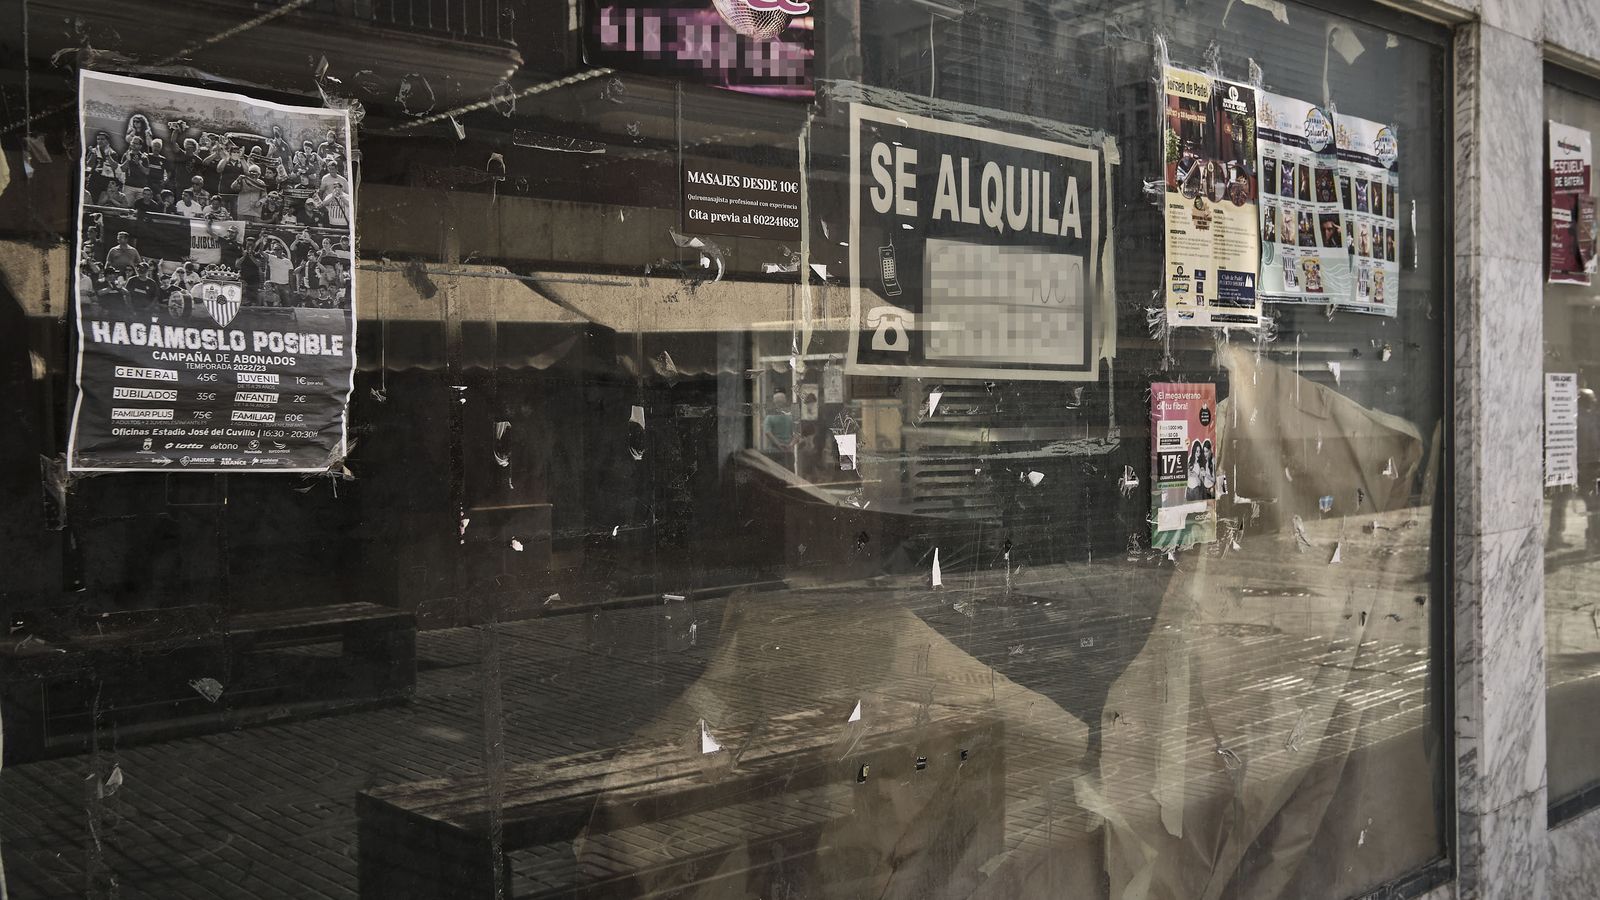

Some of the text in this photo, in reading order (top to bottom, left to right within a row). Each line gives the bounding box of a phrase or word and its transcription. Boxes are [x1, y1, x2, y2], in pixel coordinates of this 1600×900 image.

[1186, 81, 1192, 94] de
[1194, 82, 1208, 98] Padel
[1304, 120, 1328, 137] Baluarte
[1555, 160, 1584, 173] ESCUELA
[688, 170, 799, 193] MASAJES DESDE 10€
[1555, 176, 1563, 187] DE
[870, 142, 1082, 239] SE ALQUILA
[687, 193, 728, 203] Quiromasajista
[729, 198, 759, 206] profesional
[689, 209, 799, 228] Cita previa al 602241682
[91, 316, 343, 356] HAGÁMOSLO POSIBLE
[152, 351, 296, 366] CAMPAÑA DE ABONADOS
[185, 362, 267, 372] TEMPORADA 2022/23
[116, 368, 218, 382] GENERAL 45€
[238, 374, 279, 384] JUVENIL
[296, 376, 307, 385] 1€
[115, 389, 177, 400] JUBILADOS
[236, 393, 306, 403] INFANTIL 2€
[113, 410, 213, 419] FAMILIAR PLUS 75€
[232, 412, 304, 422] FAMILIAR 60€
[112, 428, 149, 436] Oficinas
[152, 428, 186, 436] Estadio
[188, 428, 209, 436] José
[1162, 454, 1181, 474] 17€
